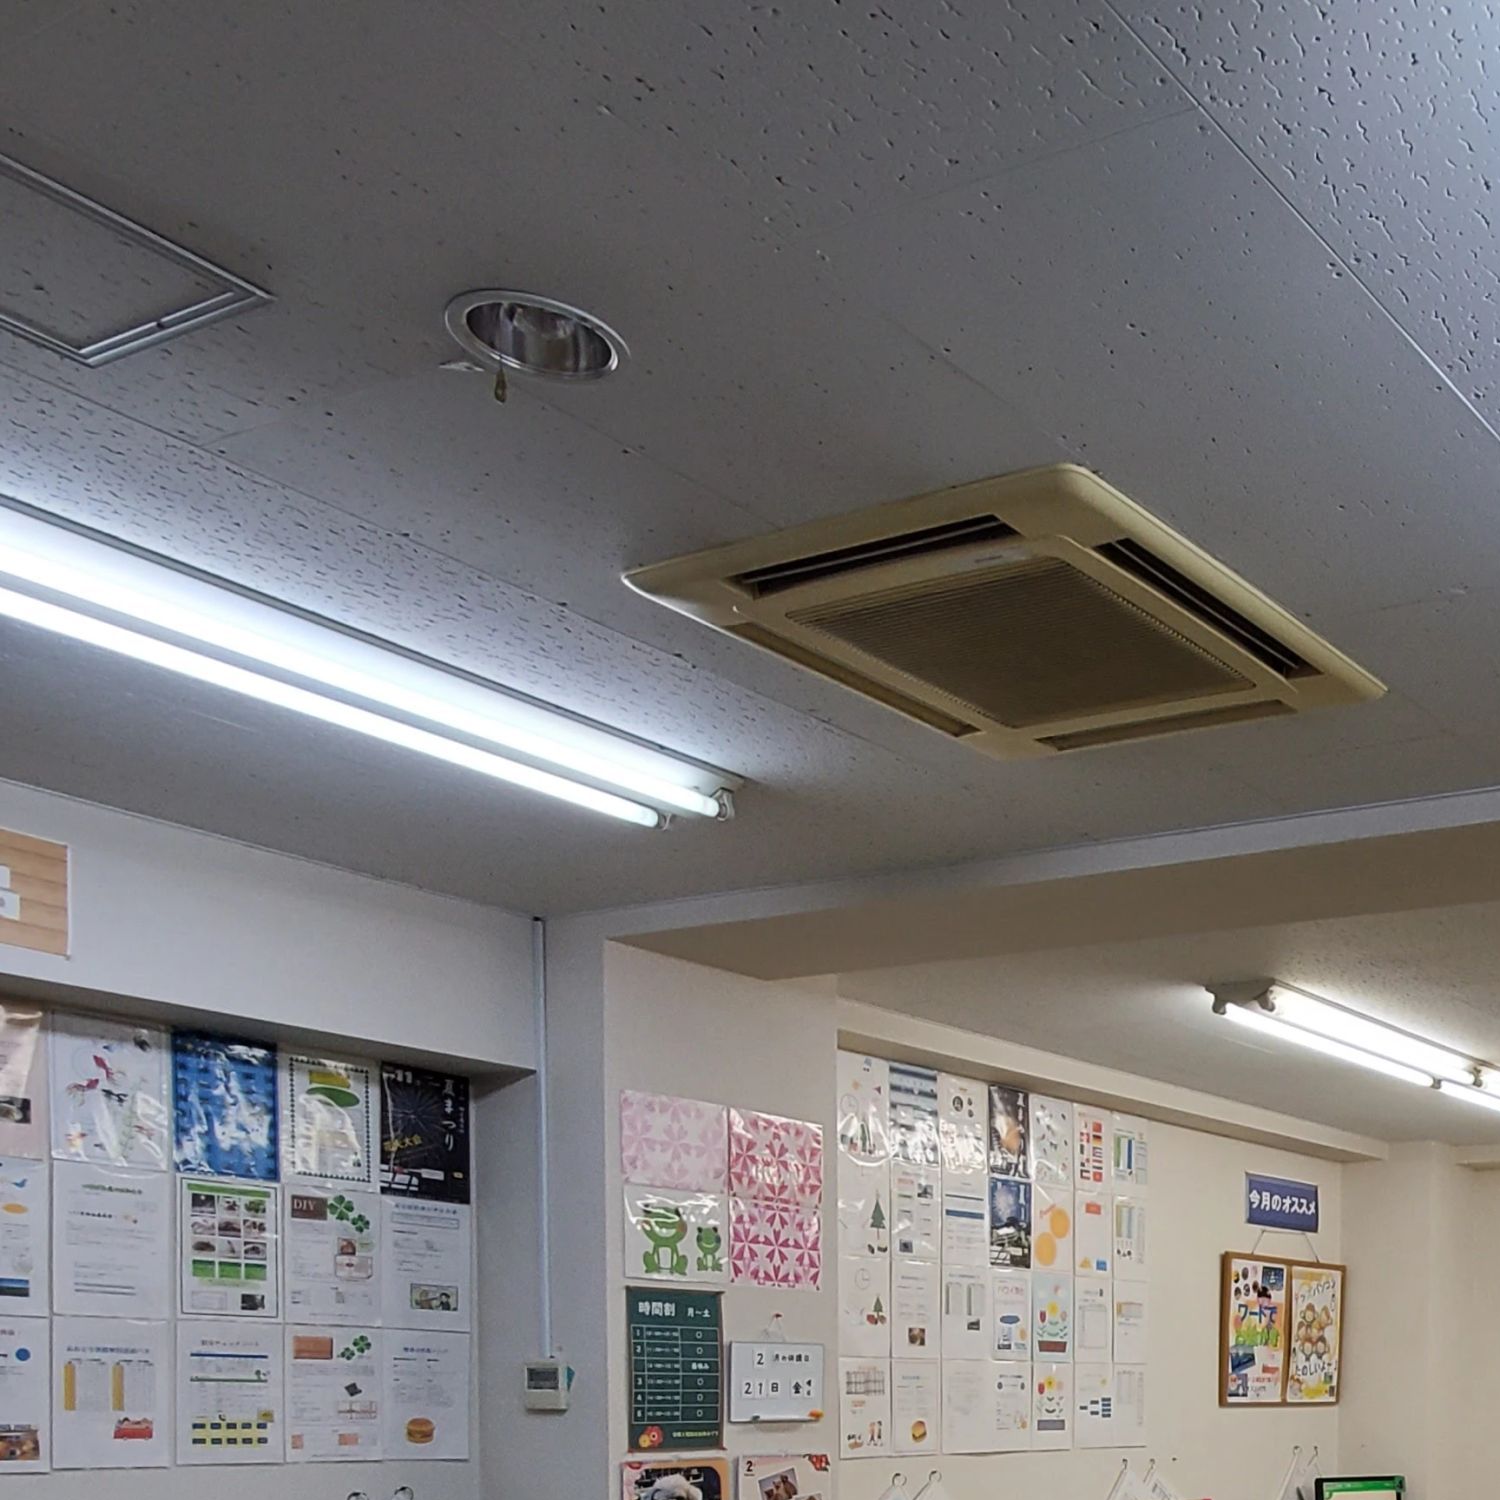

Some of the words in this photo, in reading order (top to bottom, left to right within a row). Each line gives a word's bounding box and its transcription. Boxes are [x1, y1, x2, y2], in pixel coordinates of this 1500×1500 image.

[1249, 1189, 1316, 1215] 今月のオススメ
[638, 1301, 676, 1317] 時間割
[1237, 1303, 1278, 1324] ワードで
[745, 1460, 753, 1472] 2
